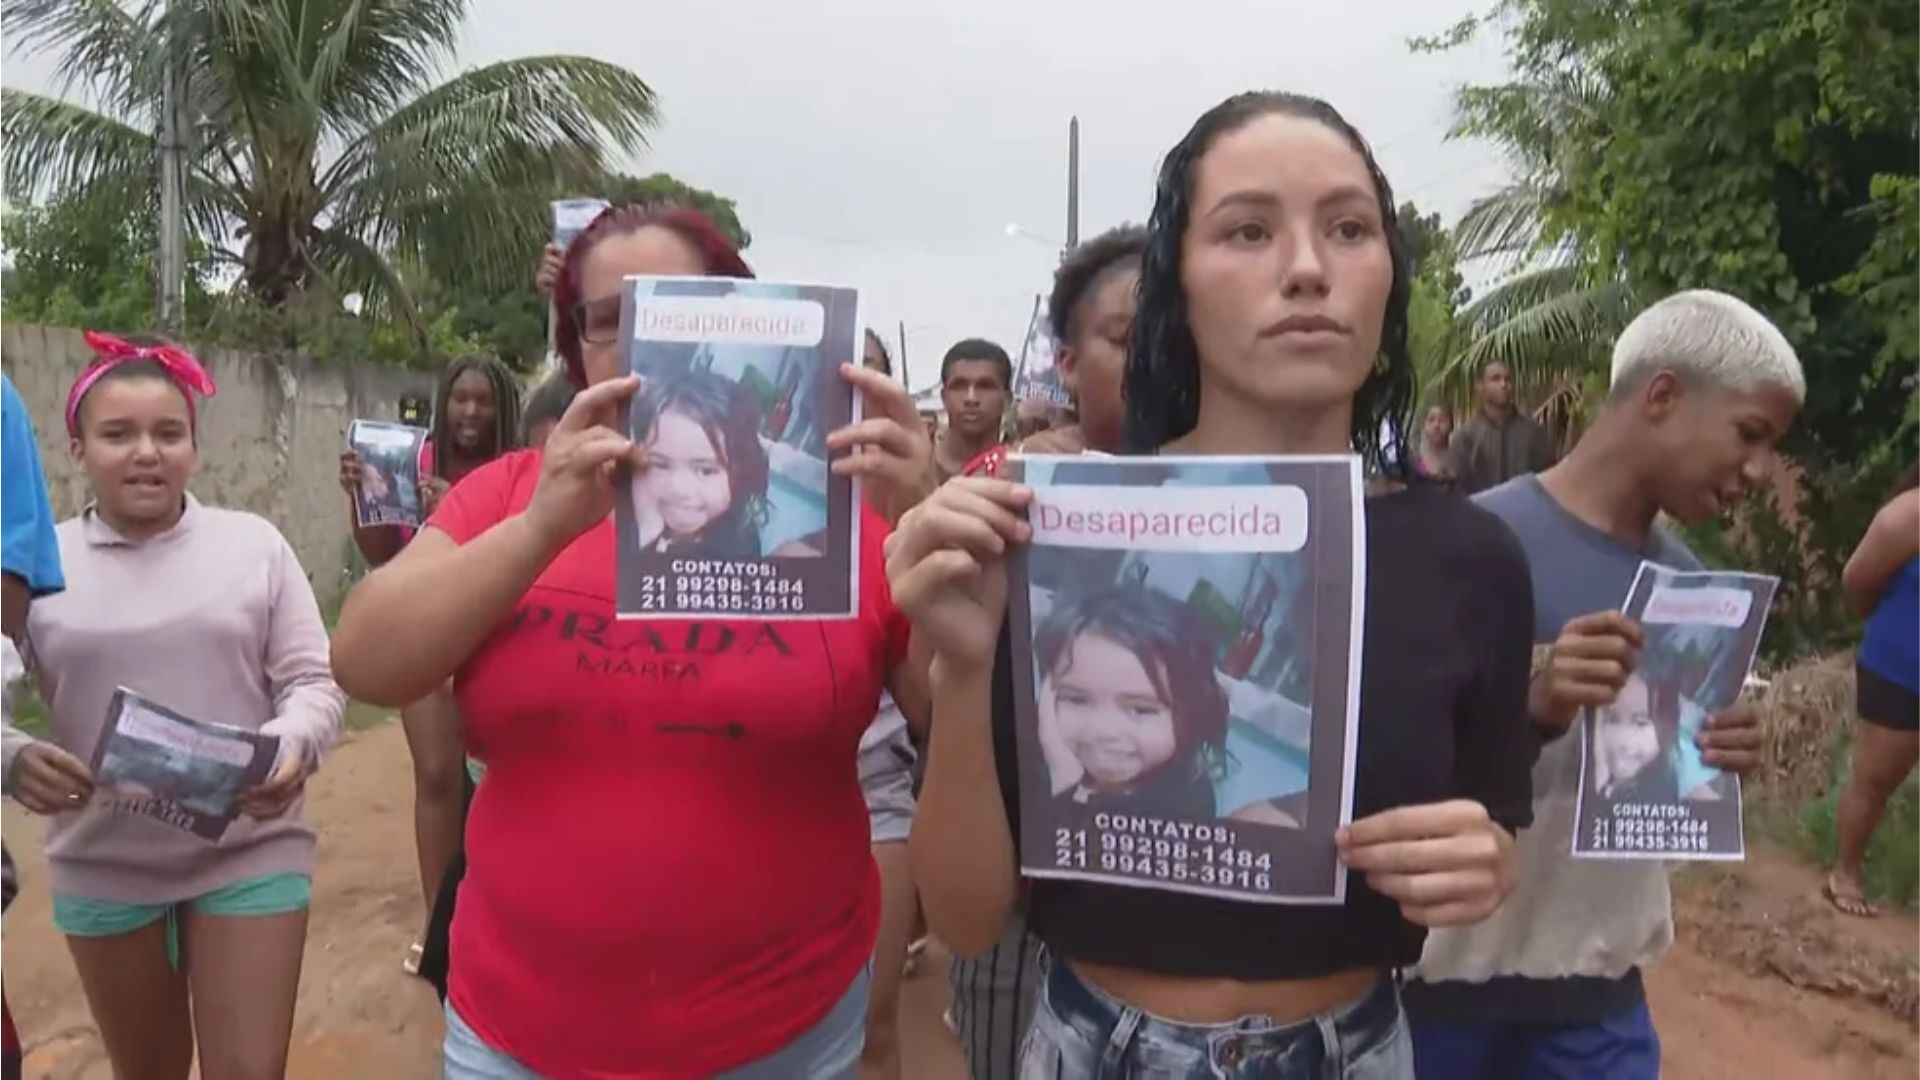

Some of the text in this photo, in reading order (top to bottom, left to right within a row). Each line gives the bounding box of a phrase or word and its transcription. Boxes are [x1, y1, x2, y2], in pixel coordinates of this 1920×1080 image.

[643, 308, 806, 337] Desaparecida
[1040, 504, 1281, 542] Desaparecida
[672, 559, 777, 577] CONTATOS:
[642, 575, 804, 595] 21 99298-1484
[642, 592, 804, 611] 21 99435-3916
[511, 606, 793, 656] PRADA
[1095, 811, 1237, 845] CONTATOS:
[1592, 817, 1609, 833] 21
[1056, 828, 1272, 872] 21 99298-1484
[1592, 833, 1609, 849] 21
[1056, 848, 1271, 891] 21 99435-3916
